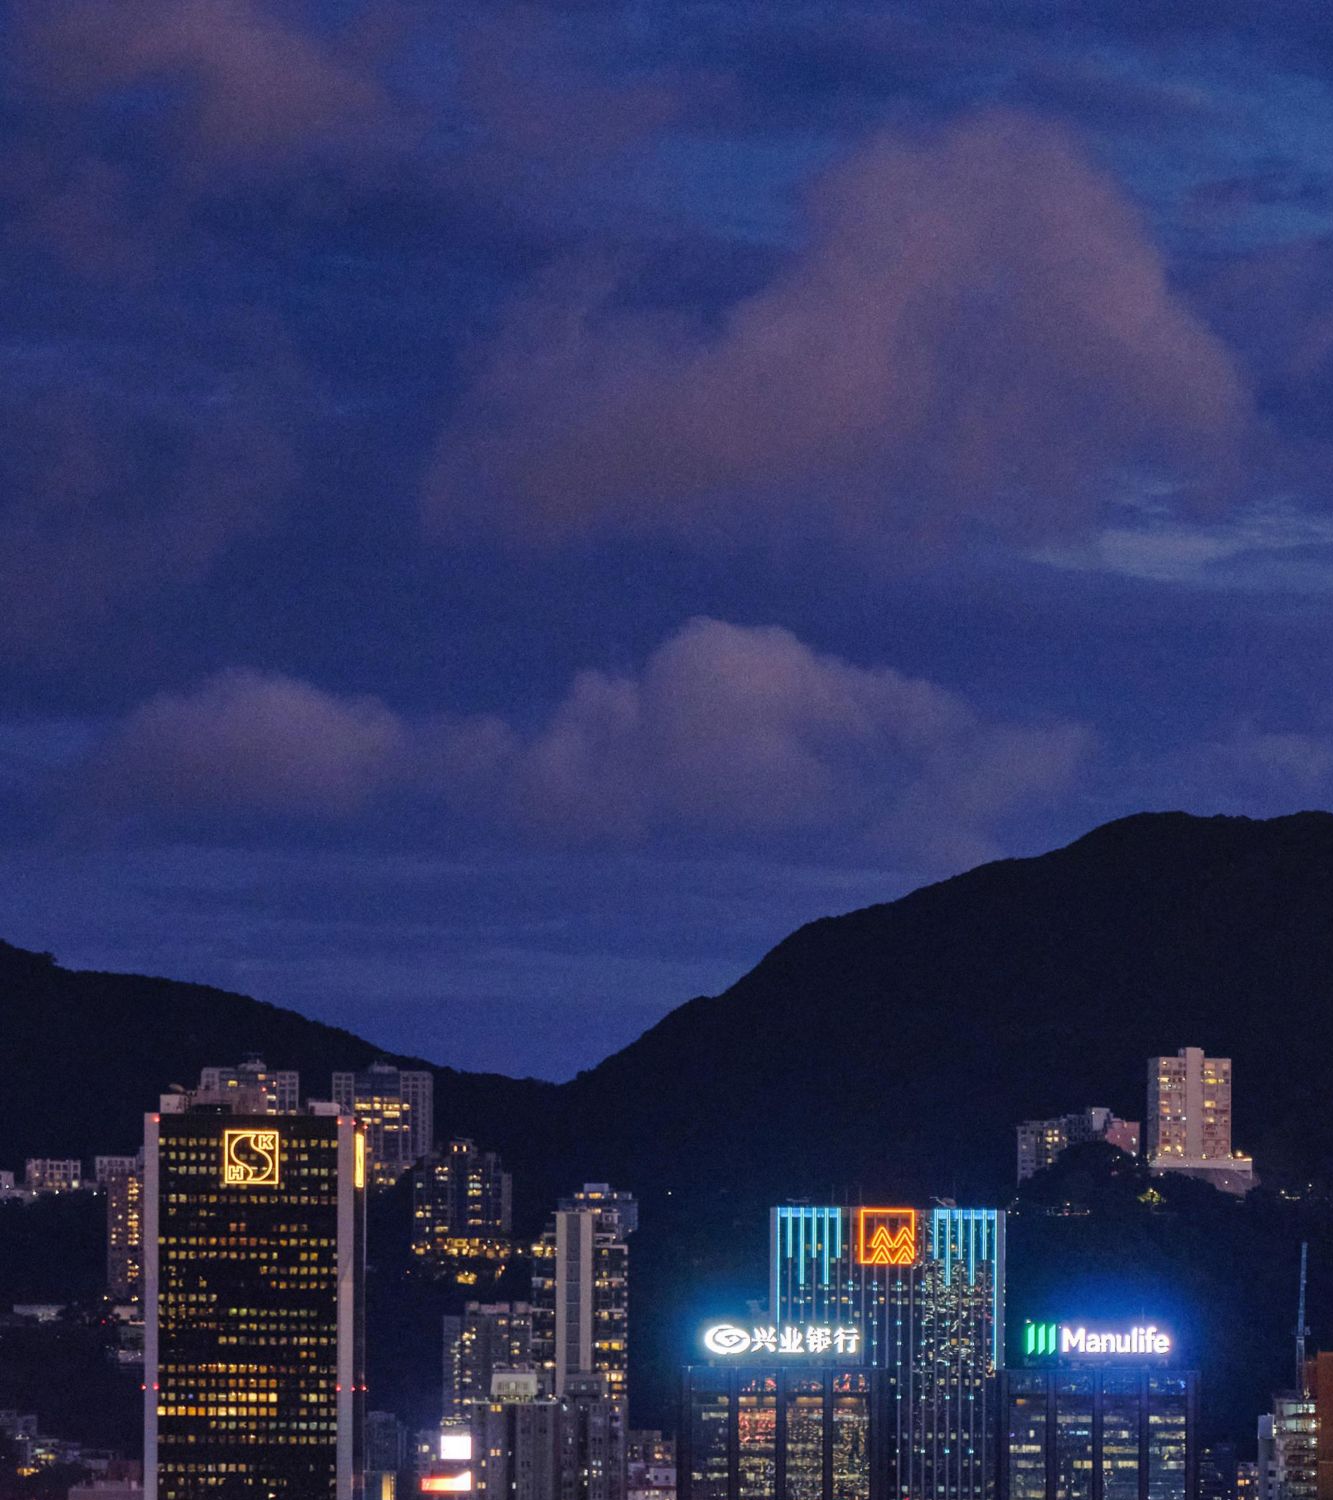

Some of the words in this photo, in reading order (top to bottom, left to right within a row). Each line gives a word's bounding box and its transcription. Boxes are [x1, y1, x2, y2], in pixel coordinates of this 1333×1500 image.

[751, 1325, 860, 1354] 兴业银行
[1061, 1325, 1171, 1354] Manulife
